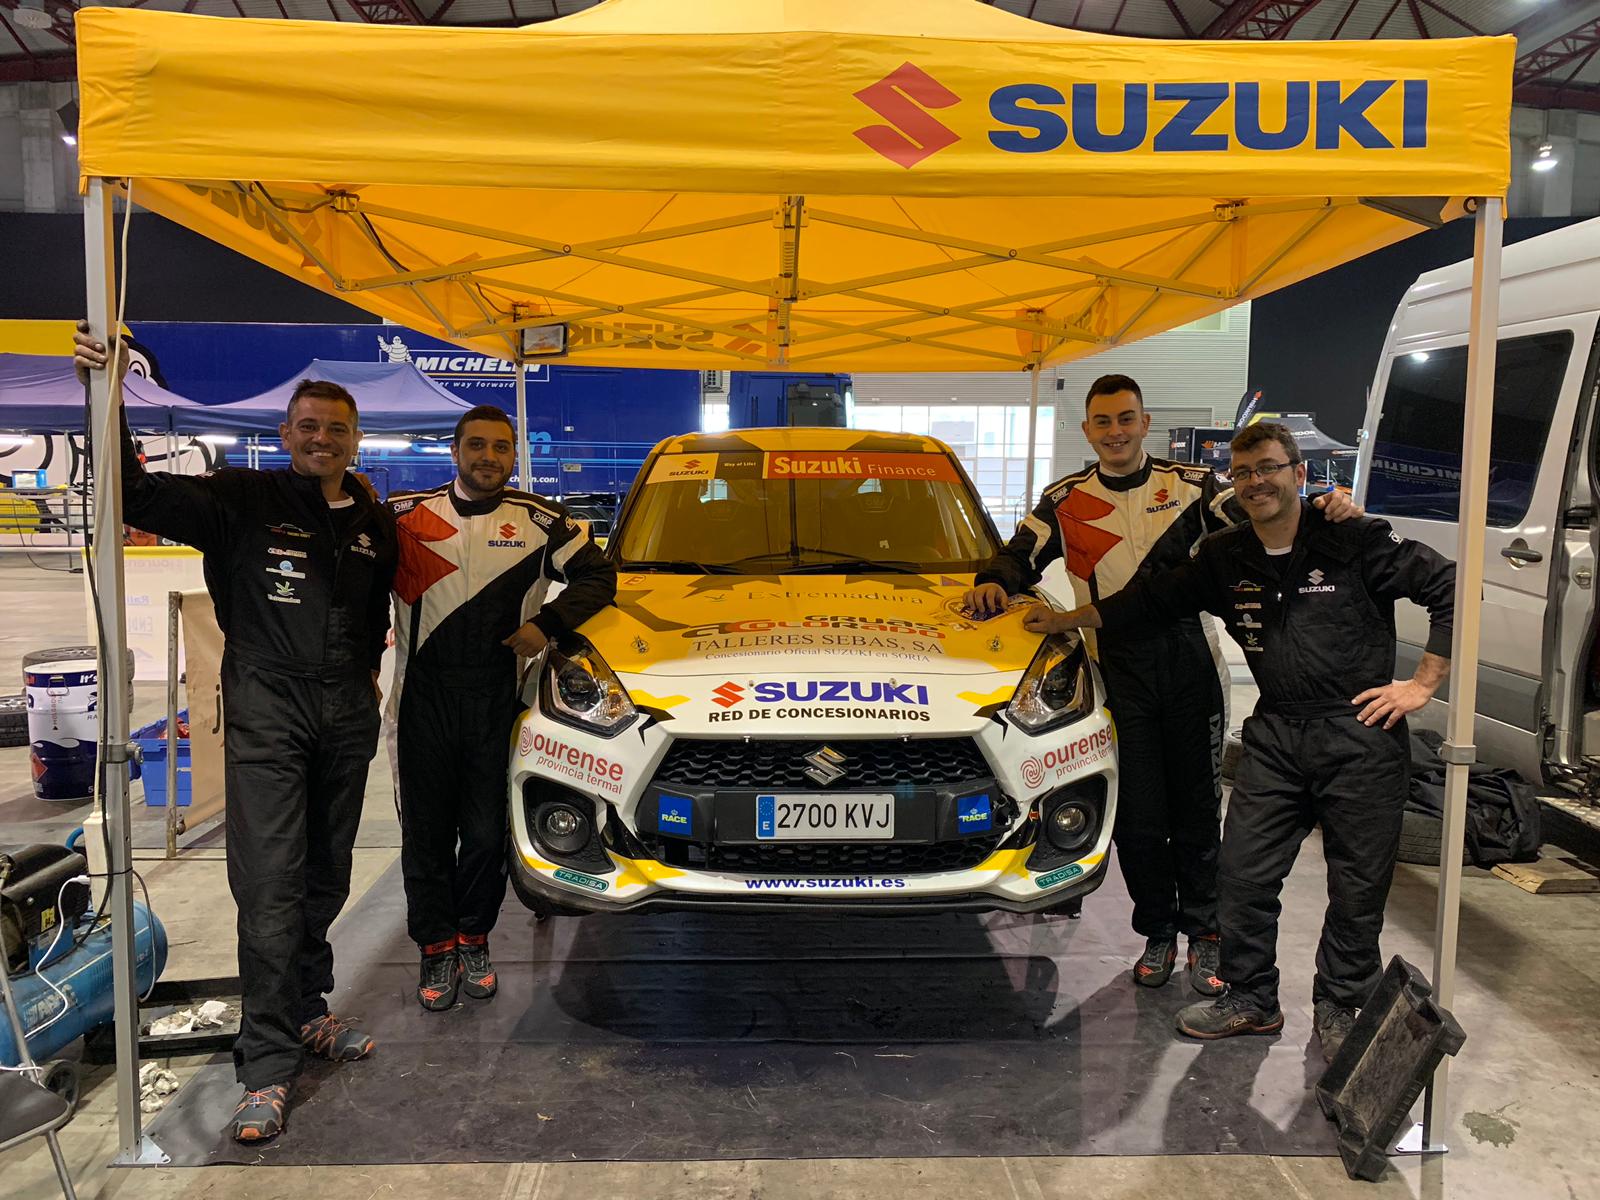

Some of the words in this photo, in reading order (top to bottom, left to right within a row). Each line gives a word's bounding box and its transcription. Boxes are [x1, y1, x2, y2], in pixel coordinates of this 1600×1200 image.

[988, 79, 1428, 153] SUZUKI
[415, 356, 541, 373] MICHELN
[774, 457, 863, 474] Suzuki
[868, 464, 937, 477] Finance
[394, 501, 413, 511] OMP
[1146, 501, 1180, 513] SUZUKI
[533, 513, 552, 526] OMP
[488, 540, 526, 548] SUZUKI
[1298, 585, 1335, 594] SUZUKI
[749, 591, 923, 604] Extremadura
[694, 634, 815, 652] TALLERES
[822, 634, 905, 651] SEBAS,
[913, 640, 944, 654] SA
[705, 648, 782, 660] Concesionario
[824, 648, 873, 657] SUZUKI
[891, 652, 930, 662] SORIA
[754, 681, 929, 705] SUZUKI
[709, 709, 743, 722] RED
[750, 709, 771, 719] DE
[776, 708, 931, 721] CONCESIONARIOS
[1043, 724, 1112, 769] ourense
[533, 734, 624, 781] ourense
[1056, 753, 1099, 779] provincia
[537, 755, 584, 781] provincia
[587, 775, 623, 795] termal
[661, 814, 688, 824] RACE
[777, 804, 837, 828] 2700
[845, 804, 890, 828] KVJ
[960, 813, 988, 822] RACE
[763, 821, 771, 830] E
[558, 870, 604, 890] TRADISA
[745, 876, 905, 888] www.suzuki.es
[1039, 867, 1080, 885] TRADISA
